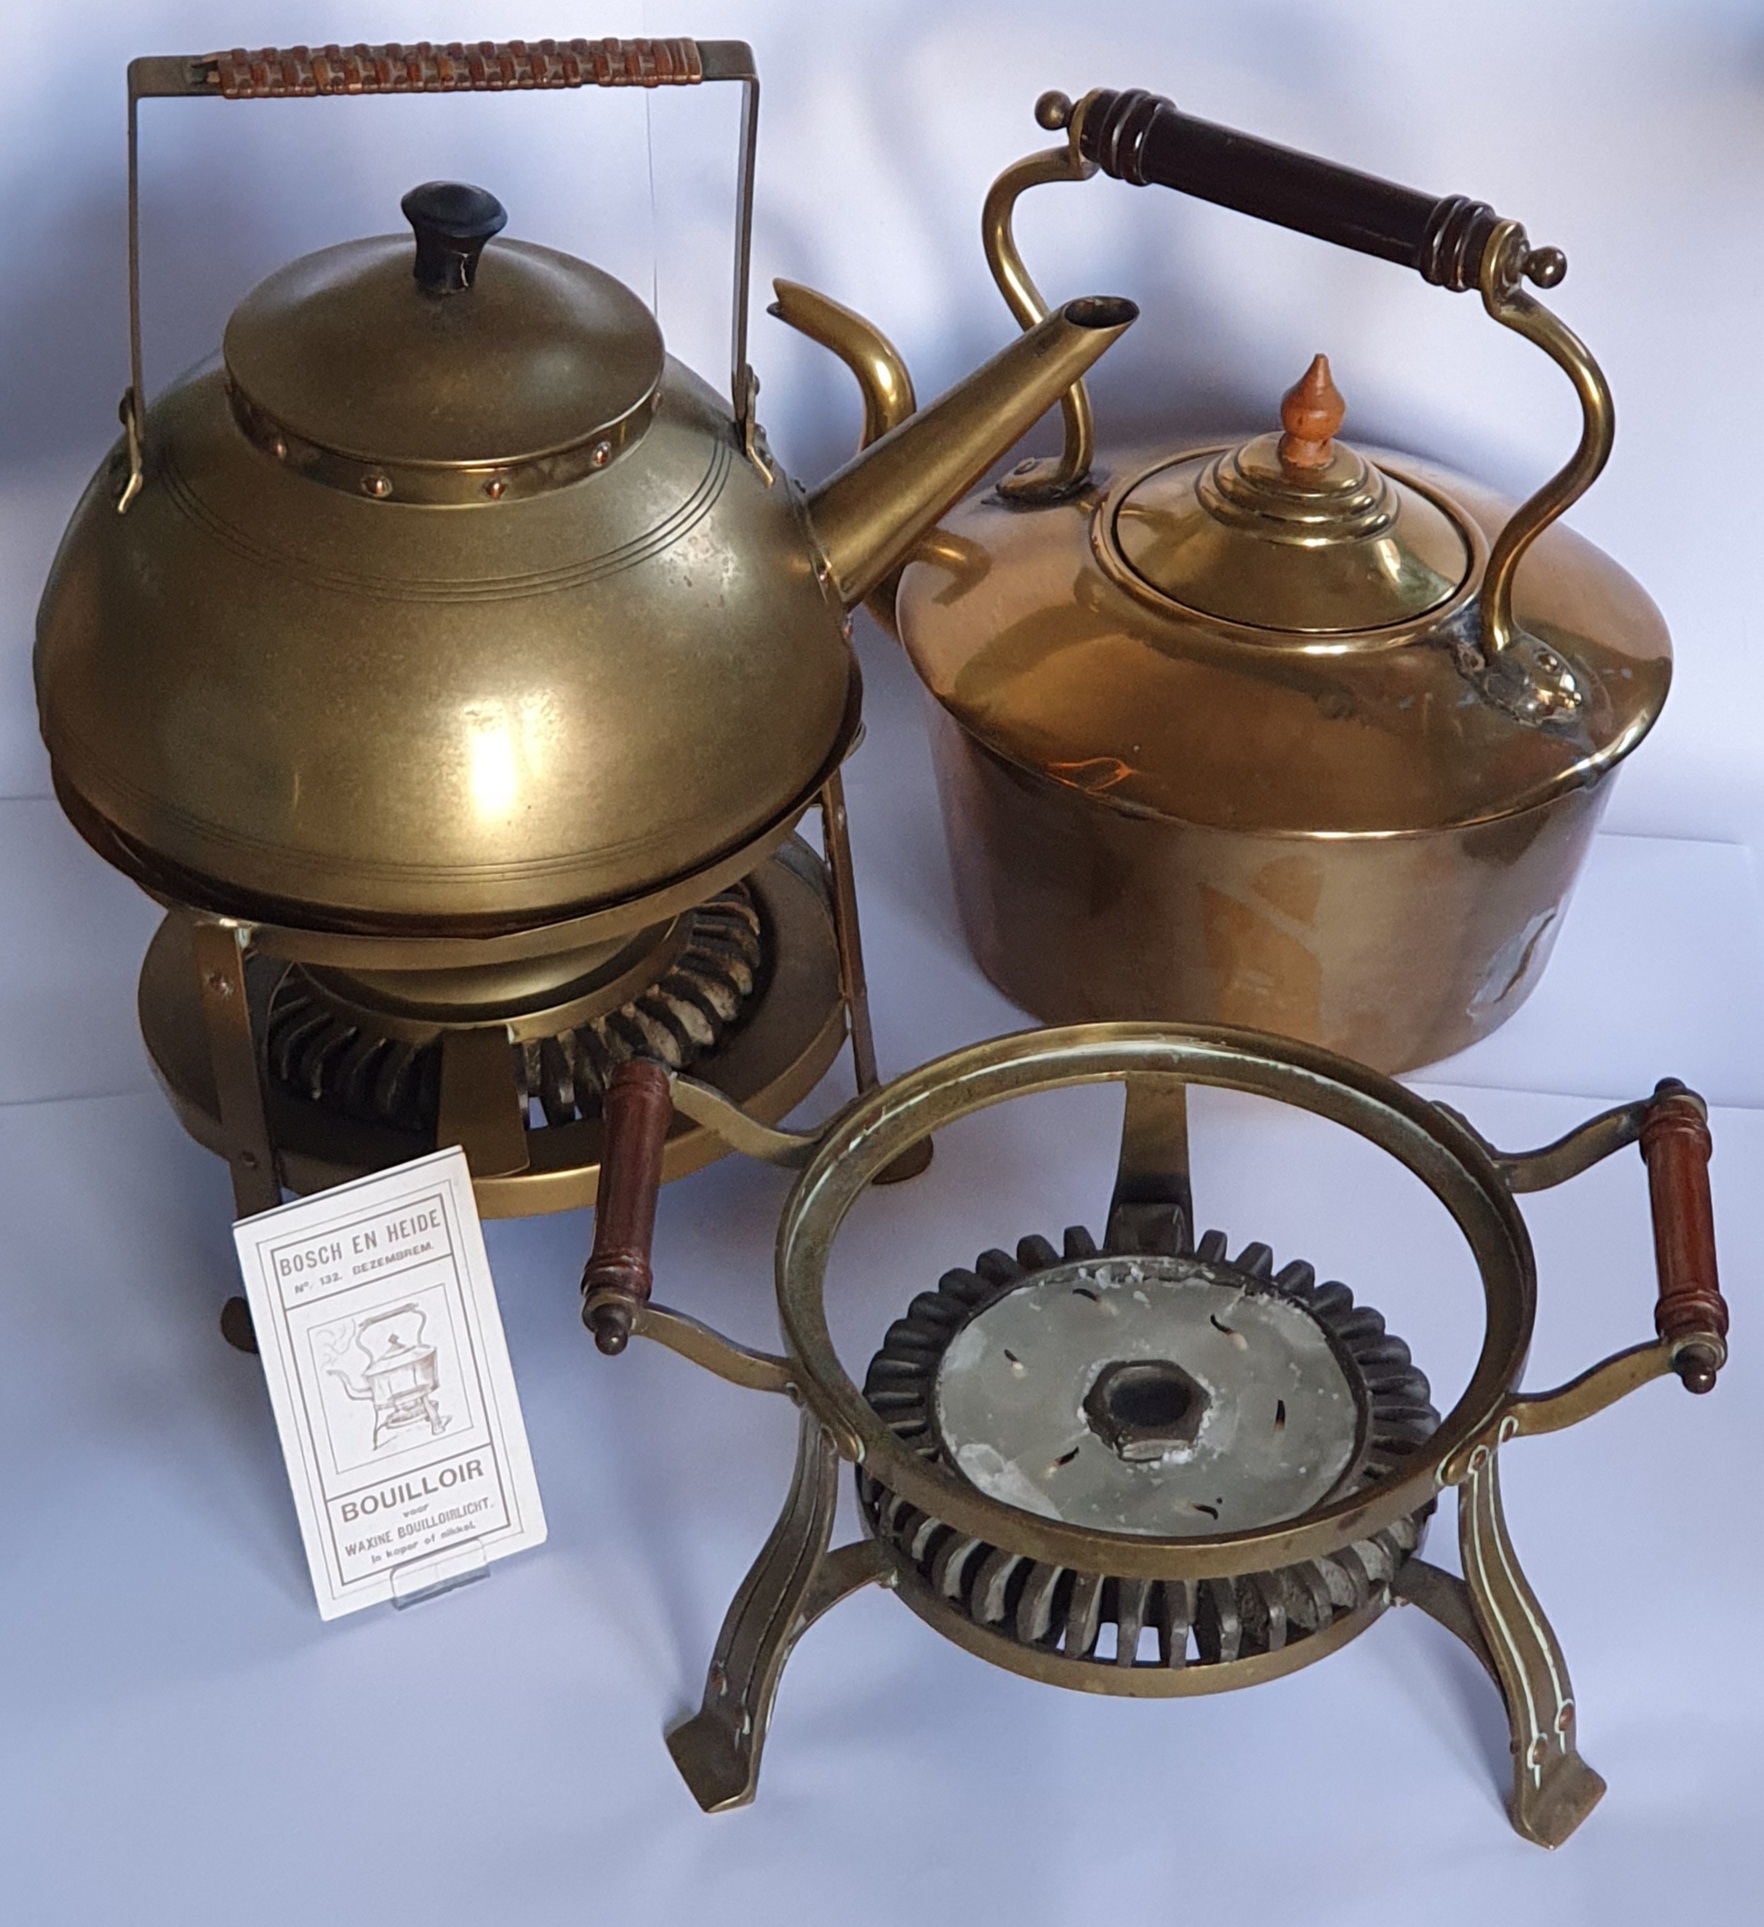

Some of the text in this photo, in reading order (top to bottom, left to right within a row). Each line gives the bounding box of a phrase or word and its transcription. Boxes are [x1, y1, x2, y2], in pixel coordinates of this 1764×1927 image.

[279, 1209, 441, 1277] BOSCH EN HEIDE
[340, 1458, 484, 1523] BOUILLOIR
[402, 1503, 430, 1518] voor
[345, 1530, 394, 1557] WAXINE
